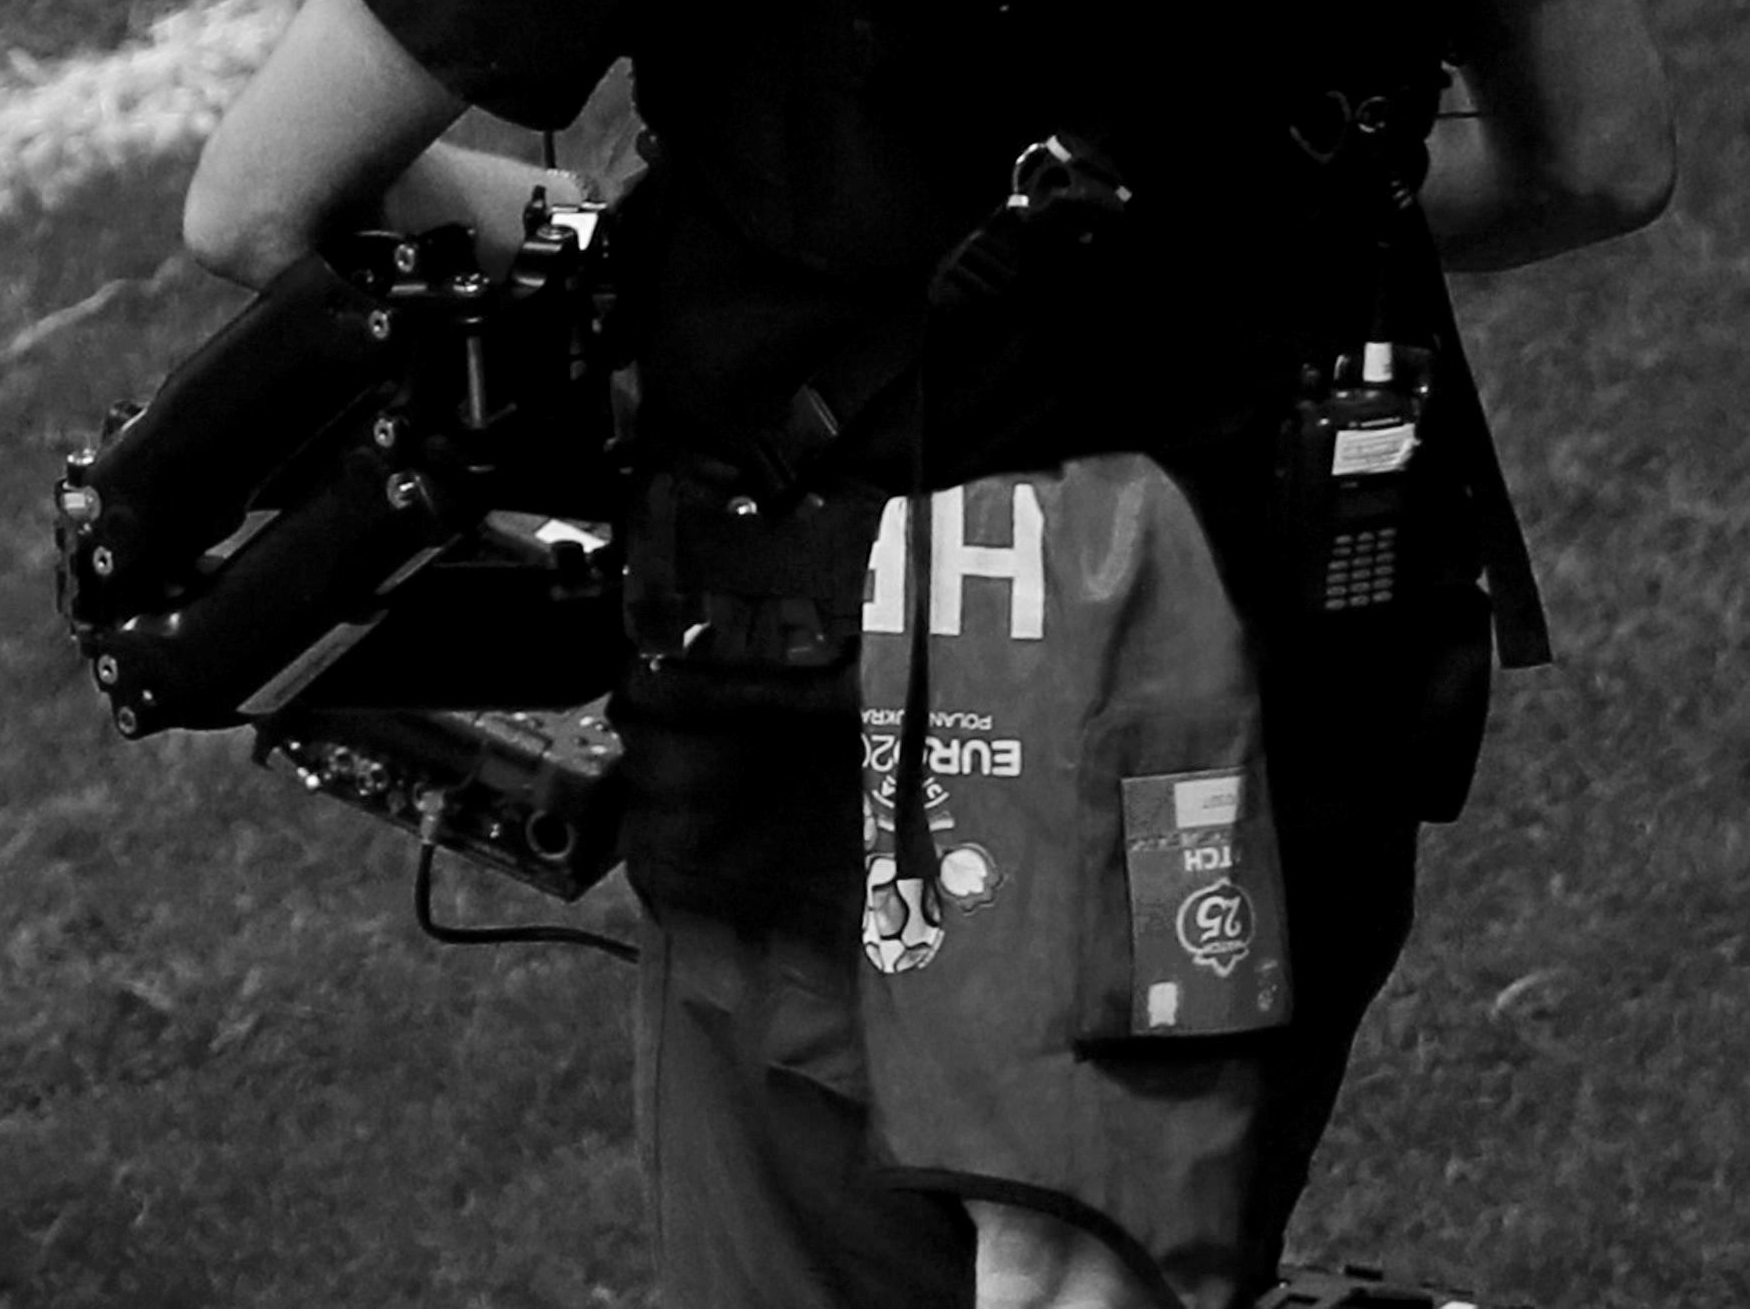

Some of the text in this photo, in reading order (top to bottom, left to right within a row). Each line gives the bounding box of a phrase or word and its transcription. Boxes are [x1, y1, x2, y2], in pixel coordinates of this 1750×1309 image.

[929, 711, 993, 731] POLAN
[1184, 845, 1234, 872] TCH
[1196, 895, 1242, 942] 25
